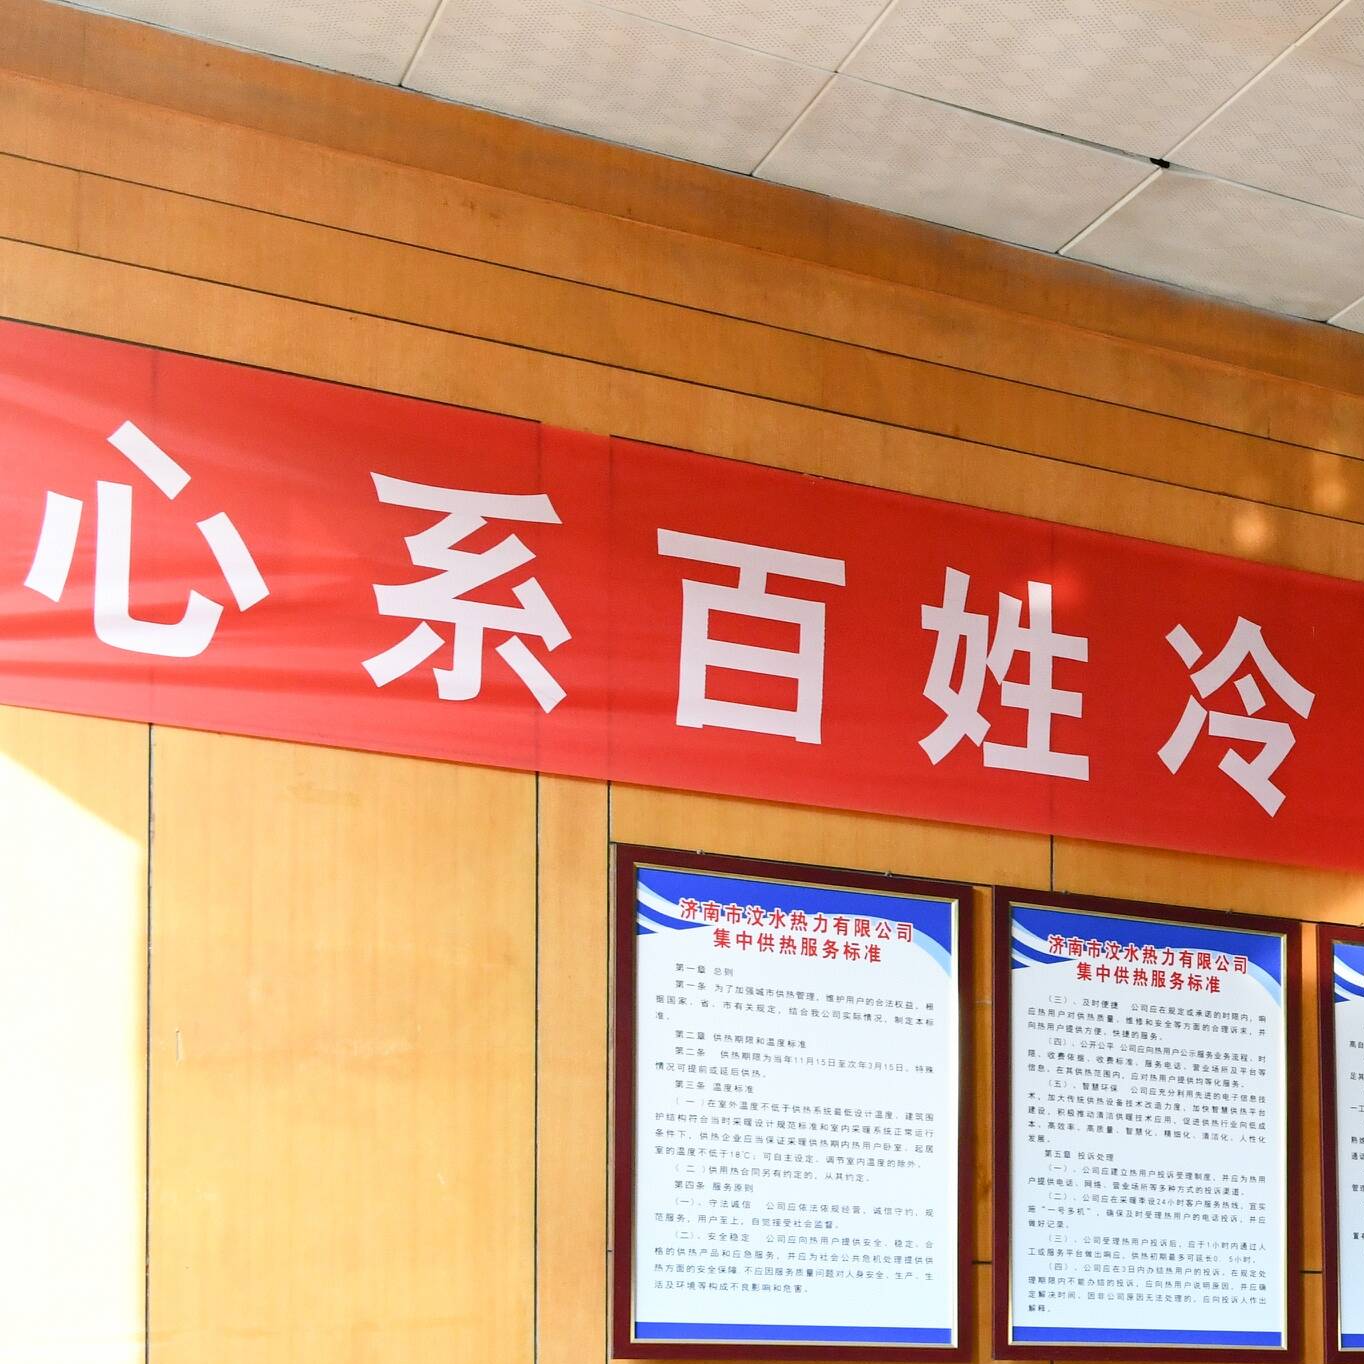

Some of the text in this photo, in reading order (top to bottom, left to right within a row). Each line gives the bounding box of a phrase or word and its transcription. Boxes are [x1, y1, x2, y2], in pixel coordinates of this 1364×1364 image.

[680, 897, 913, 946] 济南市汶水热力有限公司
[713, 925, 881, 966] 集中供热服务标准
[1048, 932, 1248, 976] 济南市汶水热力有限公司
[1076, 959, 1220, 996] 集中供热服务标准
